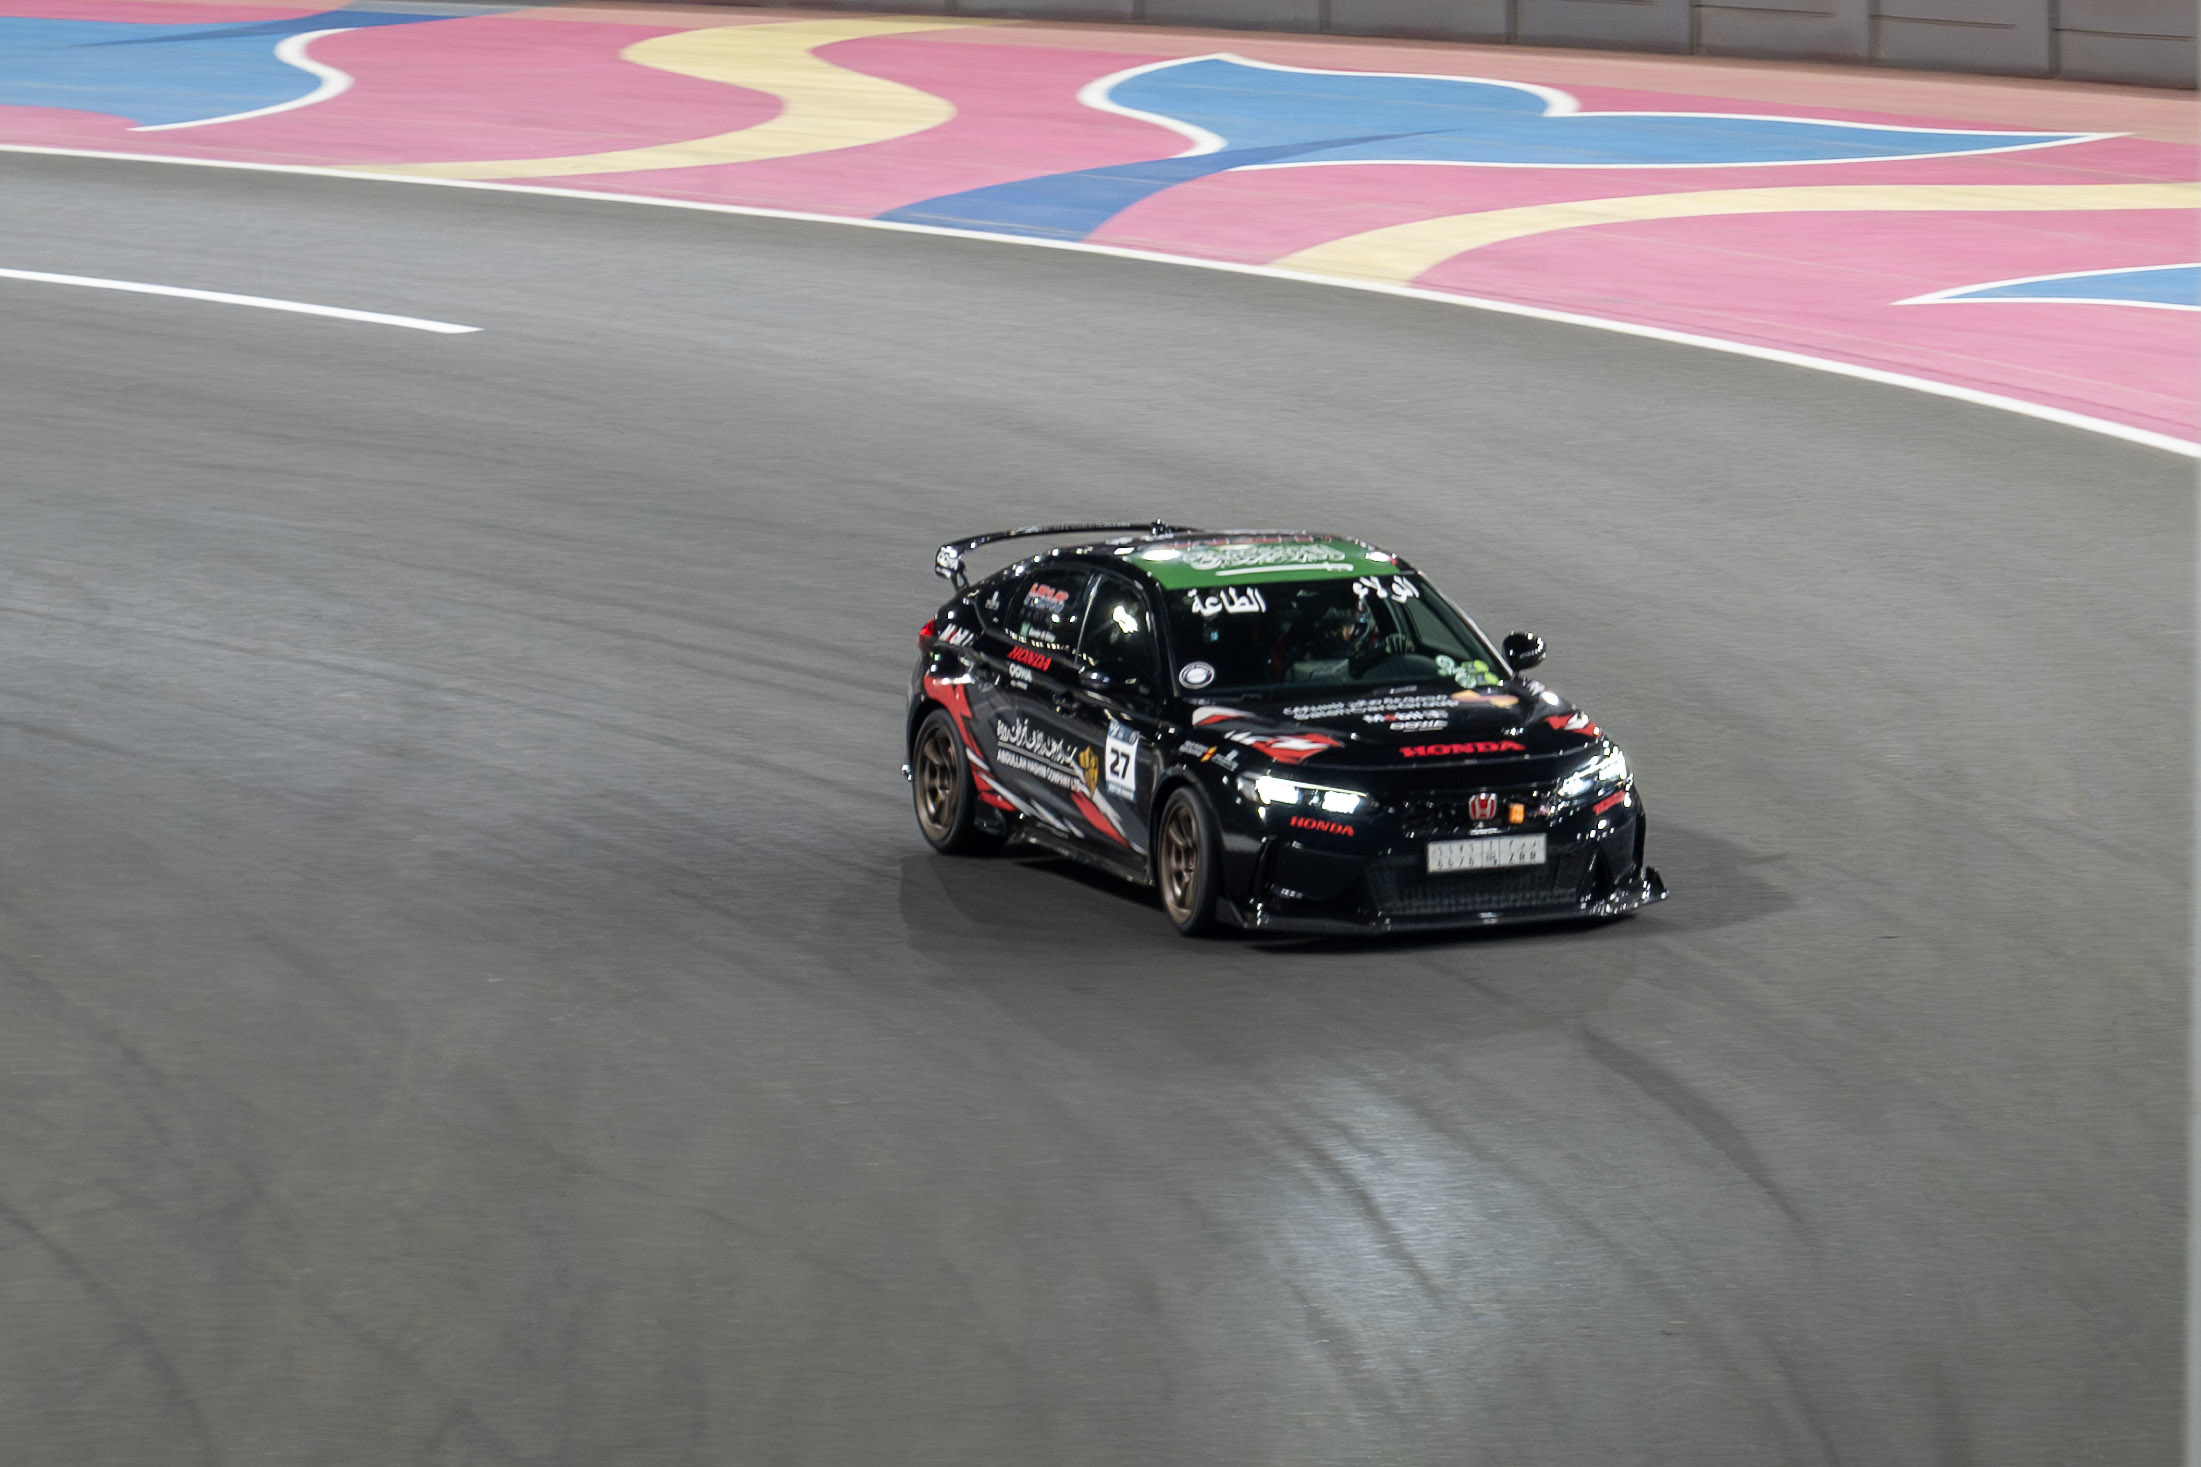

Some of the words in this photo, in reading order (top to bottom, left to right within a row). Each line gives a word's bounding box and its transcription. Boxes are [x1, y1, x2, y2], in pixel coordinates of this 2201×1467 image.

[1188, 586, 1266, 617] الطاعة
[1008, 645, 1052, 672] HONDA
[1400, 740, 1526, 758] HONDA
[1109, 747, 1131, 780] 27
[1289, 815, 1355, 837] HONDA
